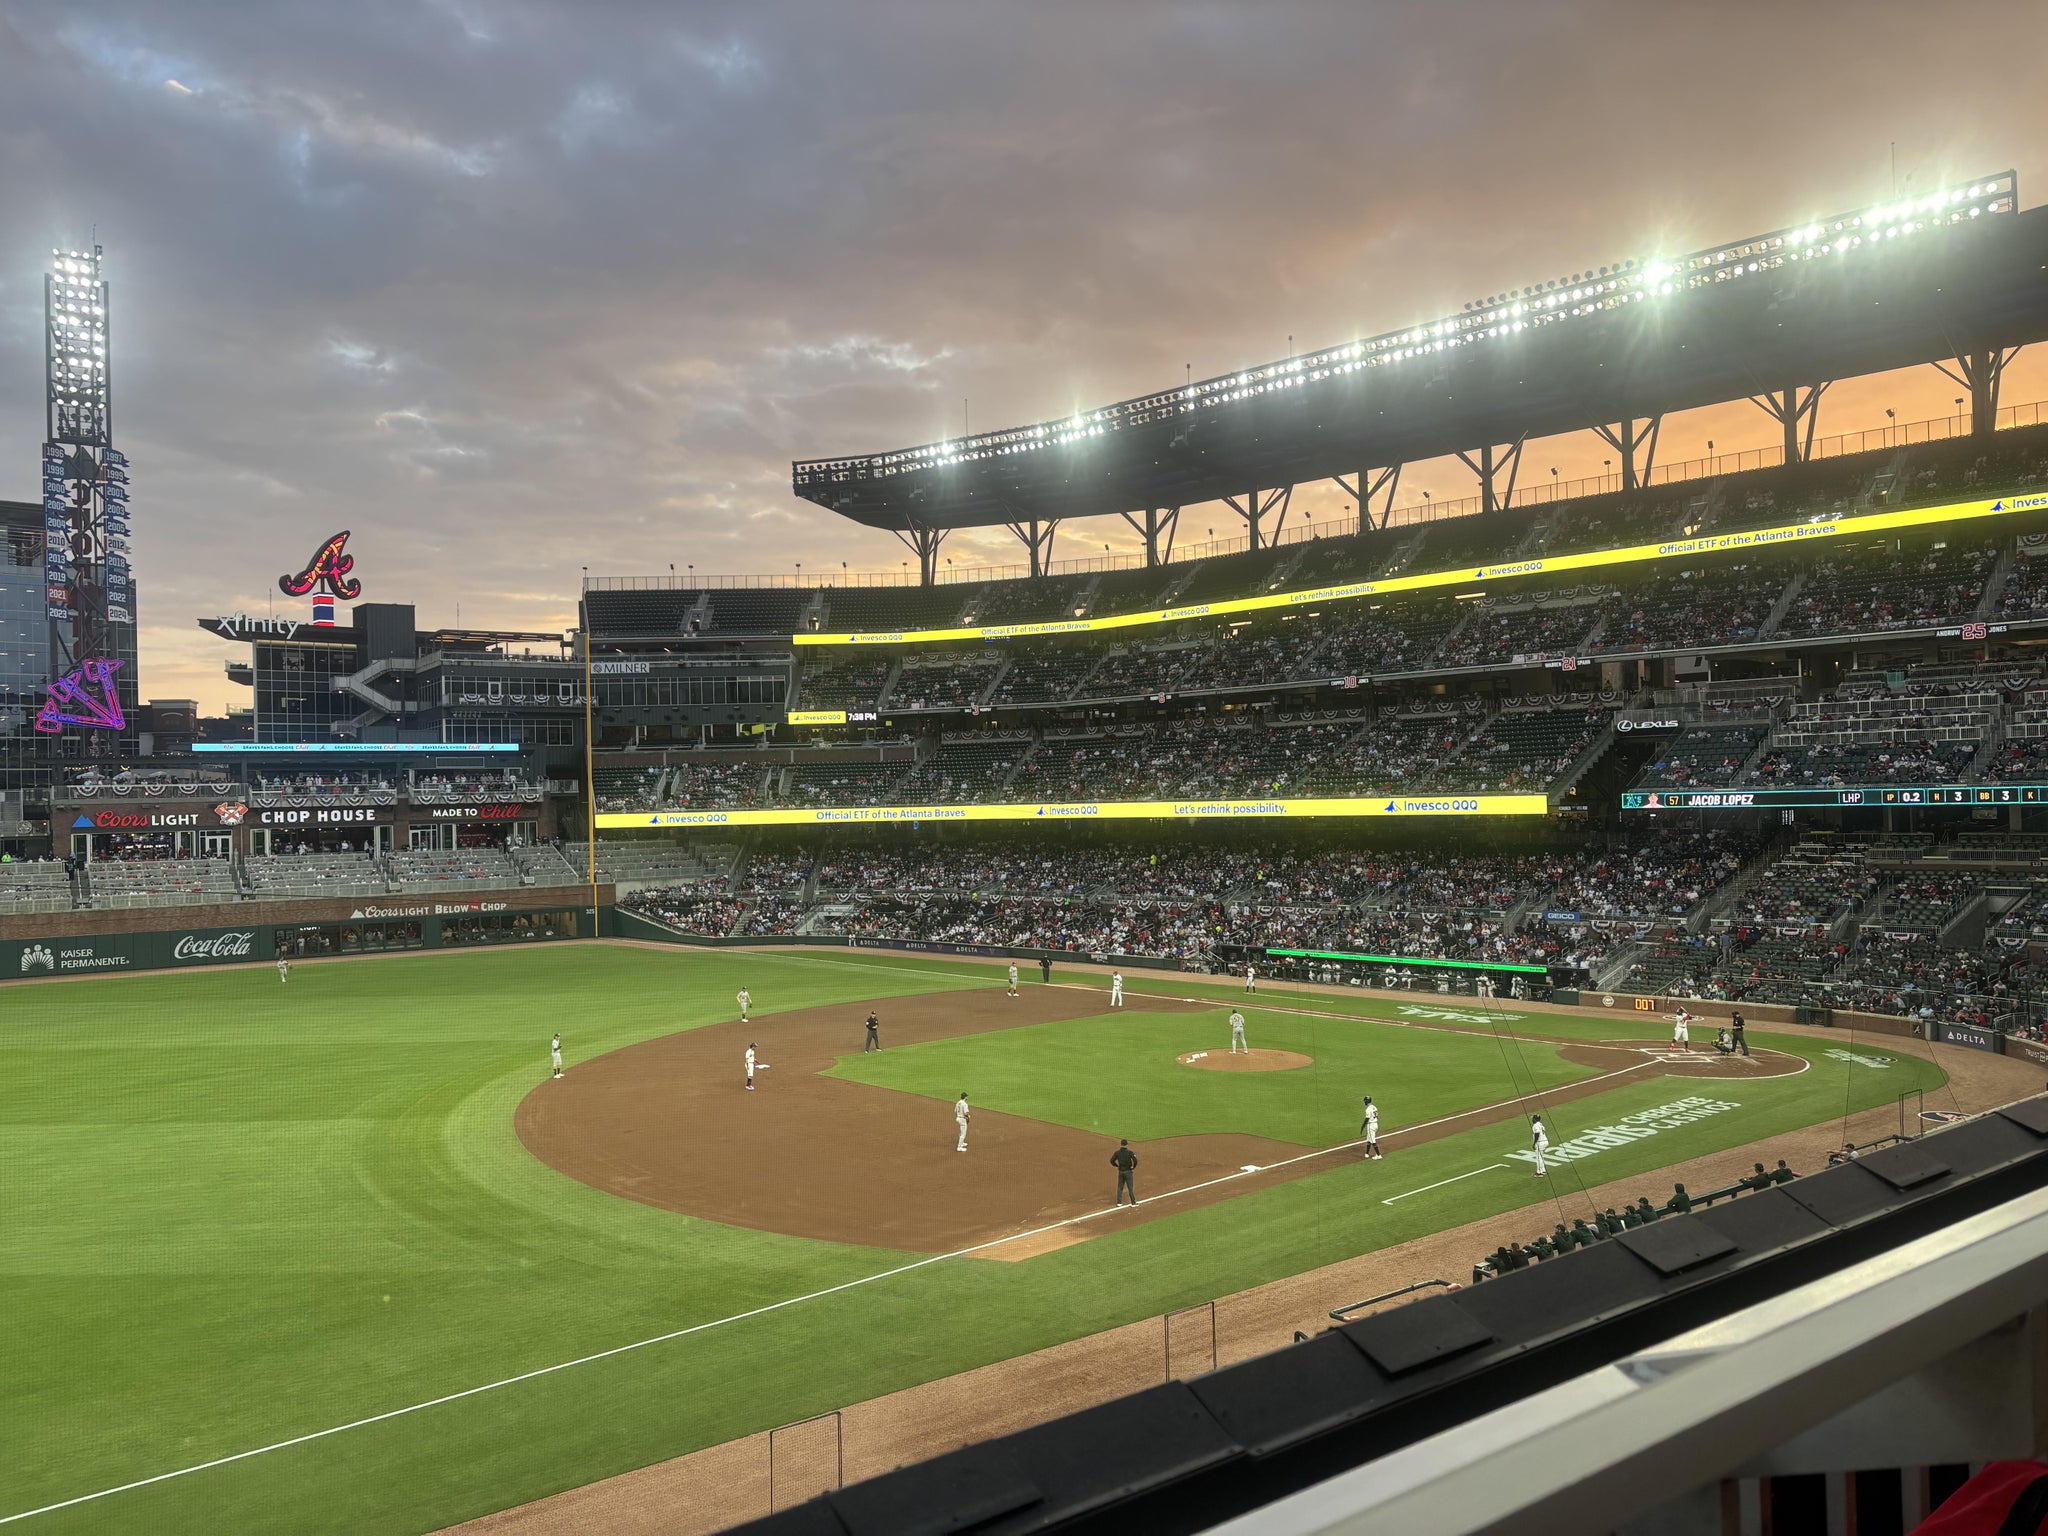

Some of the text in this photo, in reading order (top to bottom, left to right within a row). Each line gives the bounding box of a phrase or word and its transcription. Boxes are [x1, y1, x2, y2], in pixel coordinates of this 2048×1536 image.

[47, 447, 64, 458] 1996
[106, 452, 123, 462] 1997
[47, 464, 64, 475] 1998
[106, 469, 123, 480] 1999
[47, 483, 65, 493] 2000
[107, 487, 123, 498] 2001
[48, 500, 65, 511] 2002
[107, 504, 124, 515] 2003
[48, 518, 65, 529] 2004
[108, 522, 125, 532] 2005
[48, 536, 65, 546] 2010
[108, 539, 125, 550] 2012
[1659, 524, 1836, 554] Official ETF of the Atlanta Braves
[48, 553, 65, 564] 2013
[109, 556, 125, 567] 2018
[1489, 562, 1542, 576] Invesco QQQ
[49, 571, 66, 582] 2019
[109, 574, 126, 585] 2020
[49, 589, 66, 600] 2021
[109, 592, 126, 602] 2022
[1290, 585, 1376, 602] Let's rethink possibility.
[50, 608, 67, 618] 2023
[109, 608, 127, 619] 2024
[1171, 608, 1195, 616] Invesco
[217, 610, 298, 639] xfinity
[1067, 622, 1090, 630] Braves
[1962, 623, 1986, 640] 25
[860, 634, 888, 642] Invesco
[604, 663, 647, 672] MILNER
[1562, 657, 1576, 671] 21
[1344, 676, 1357, 688] 10
[1634, 720, 1678, 728] LEXUS
[1669, 796, 1679, 805] 57
[1689, 794, 1754, 806] JACOB LOPEZ
[1843, 793, 1861, 803] LHP
[1902, 792, 1920, 802] 0.2
[1954, 792, 1962, 801] 3
[2002, 791, 2010, 800] 3
[433, 804, 522, 818] MADE TO Chill
[1049, 806, 1098, 815] Invesco QQQ
[1174, 803, 1287, 815] Let's rethink possibility.
[1404, 800, 1478, 811] Invesco QQQ
[96, 810, 199, 828] Coors LIGHT
[261, 809, 376, 823] CHOP HOUSE
[666, 814, 727, 823] Invesco QQQ
[816, 808, 966, 820] Official ETF of the Atlanta Braves
[365, 906, 399, 918] Coors
[400, 907, 430, 916] LIGHT
[435, 904, 469, 914] BELOW
[481, 902, 507, 911] CHOP
[174, 932, 255, 959] Coca-Cola
[61, 949, 93, 958] KAISER
[61, 956, 126, 968] PERMANENTE
[1635, 999, 1654, 1010] 007
[1956, 1033, 1985, 1045] DELTA
[1621, 1096, 1715, 1125] CHEROKEE
[1648, 1101, 1742, 1129] CASINOS
